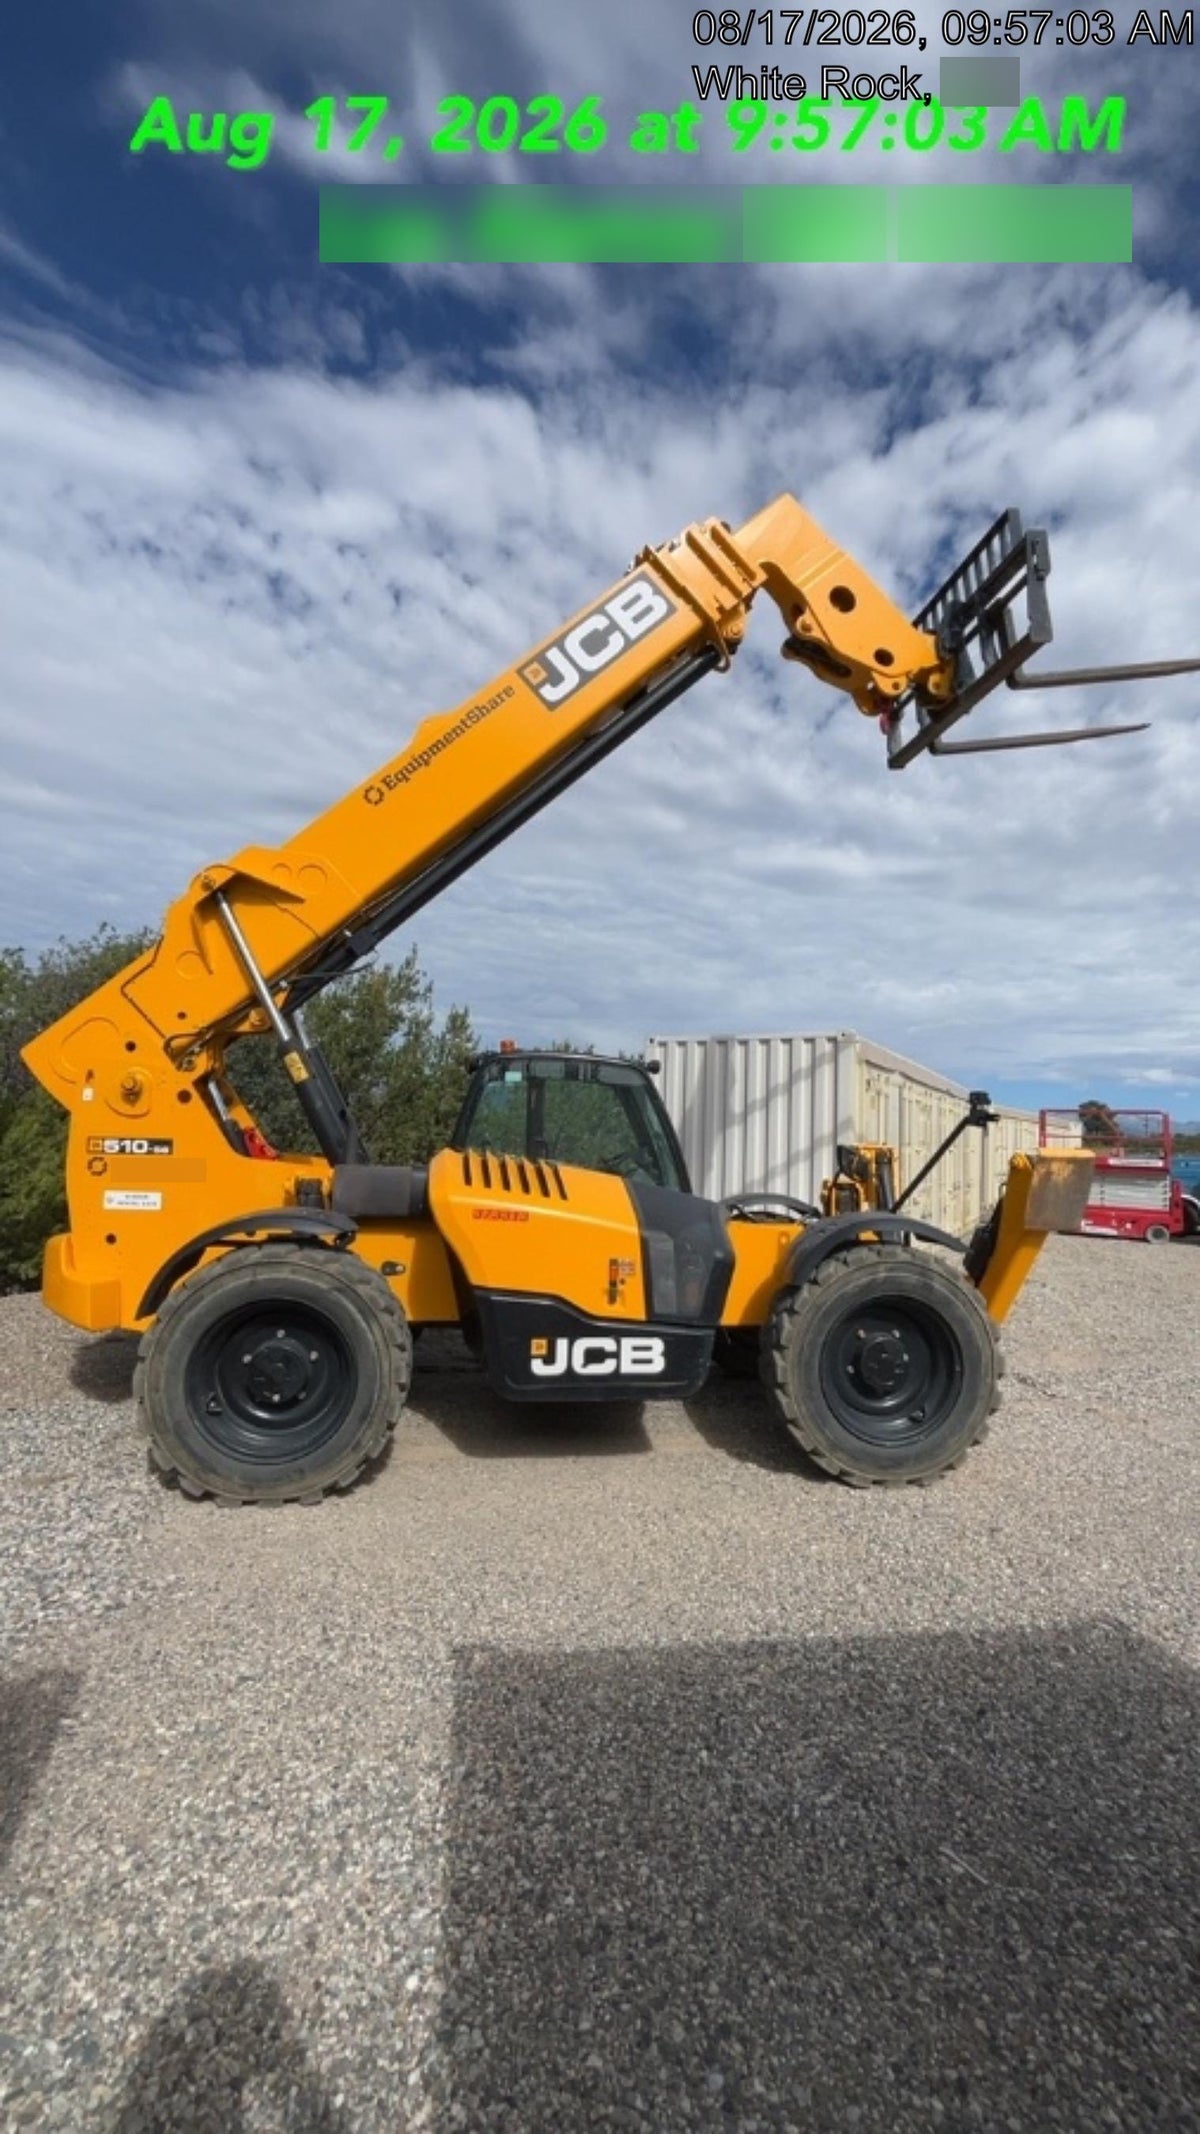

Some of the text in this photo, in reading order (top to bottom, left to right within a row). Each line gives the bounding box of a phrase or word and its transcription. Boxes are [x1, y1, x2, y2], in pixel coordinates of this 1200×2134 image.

[539, 579, 669, 703] JCB
[380, 683, 516, 792] EquipmentShare
[530, 1337, 665, 1376] JCB
